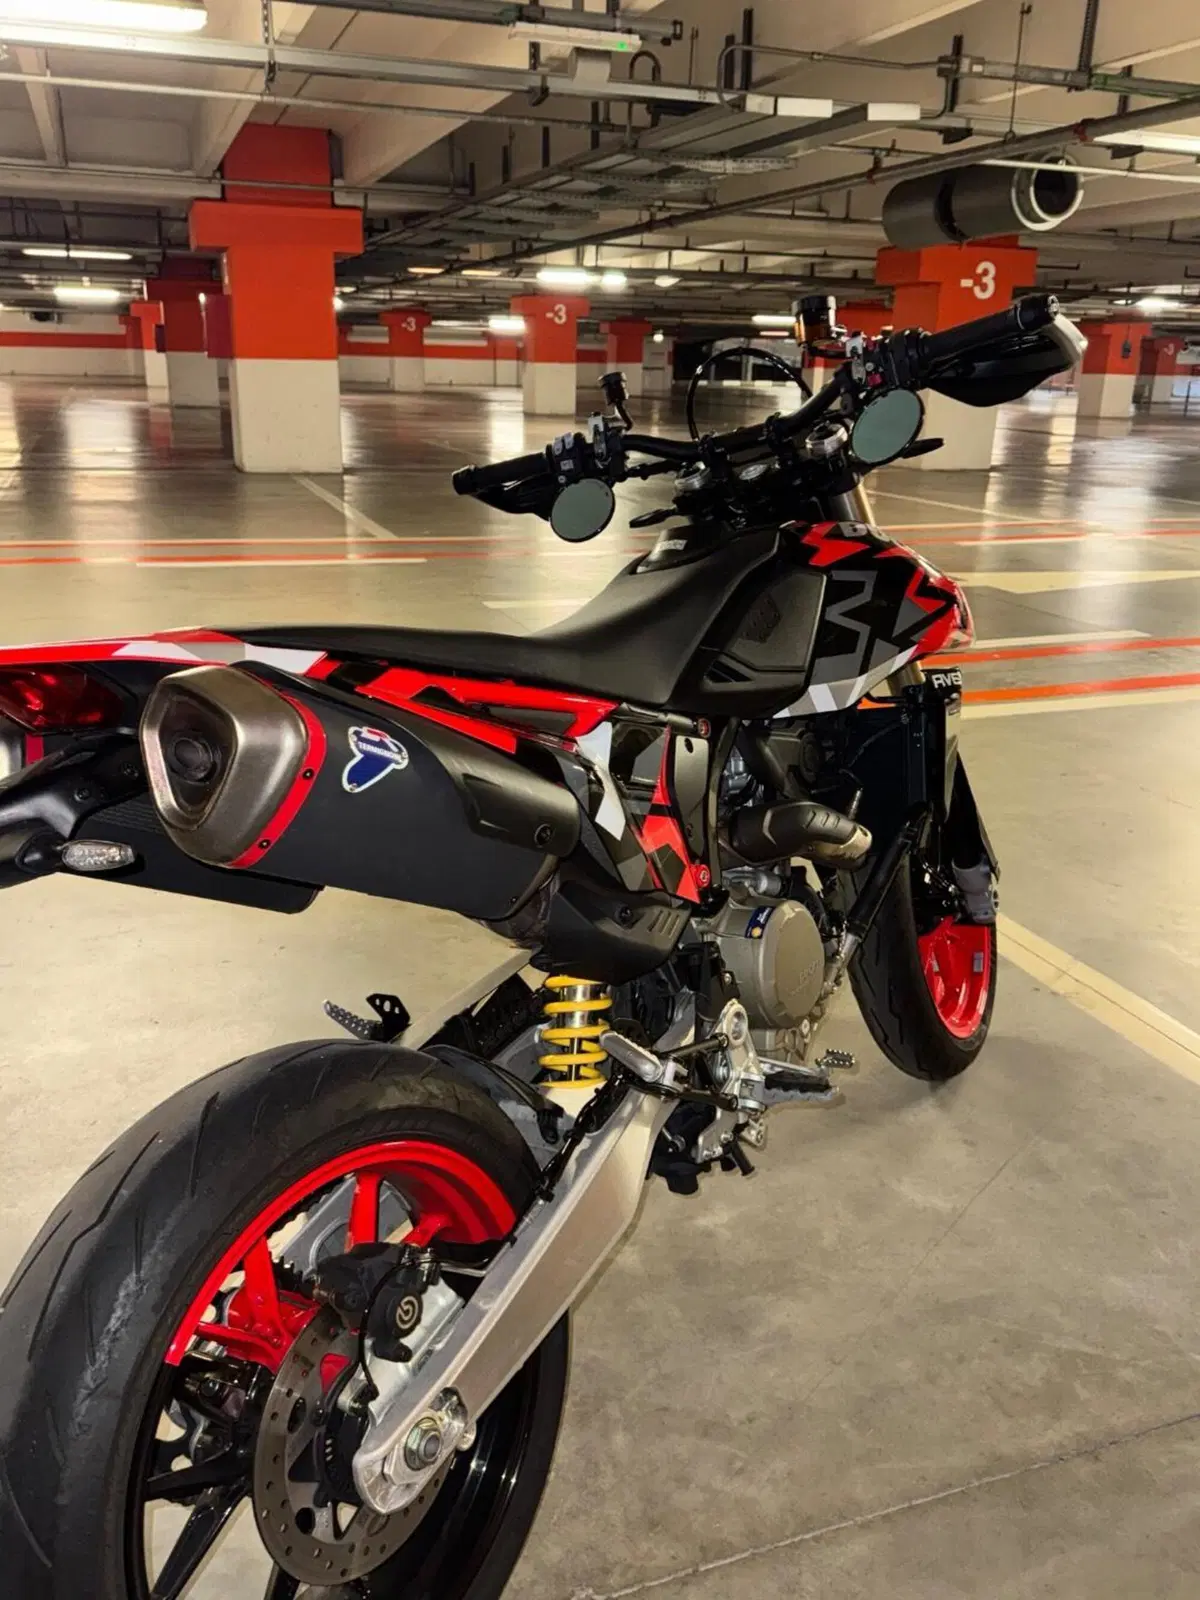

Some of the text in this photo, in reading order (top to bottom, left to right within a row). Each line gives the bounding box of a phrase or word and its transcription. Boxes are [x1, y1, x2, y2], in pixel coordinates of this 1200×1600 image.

[960, 261, 996, 300] -3
[401, 316, 416, 332] -3
[545, 303, 567, 325] -3
